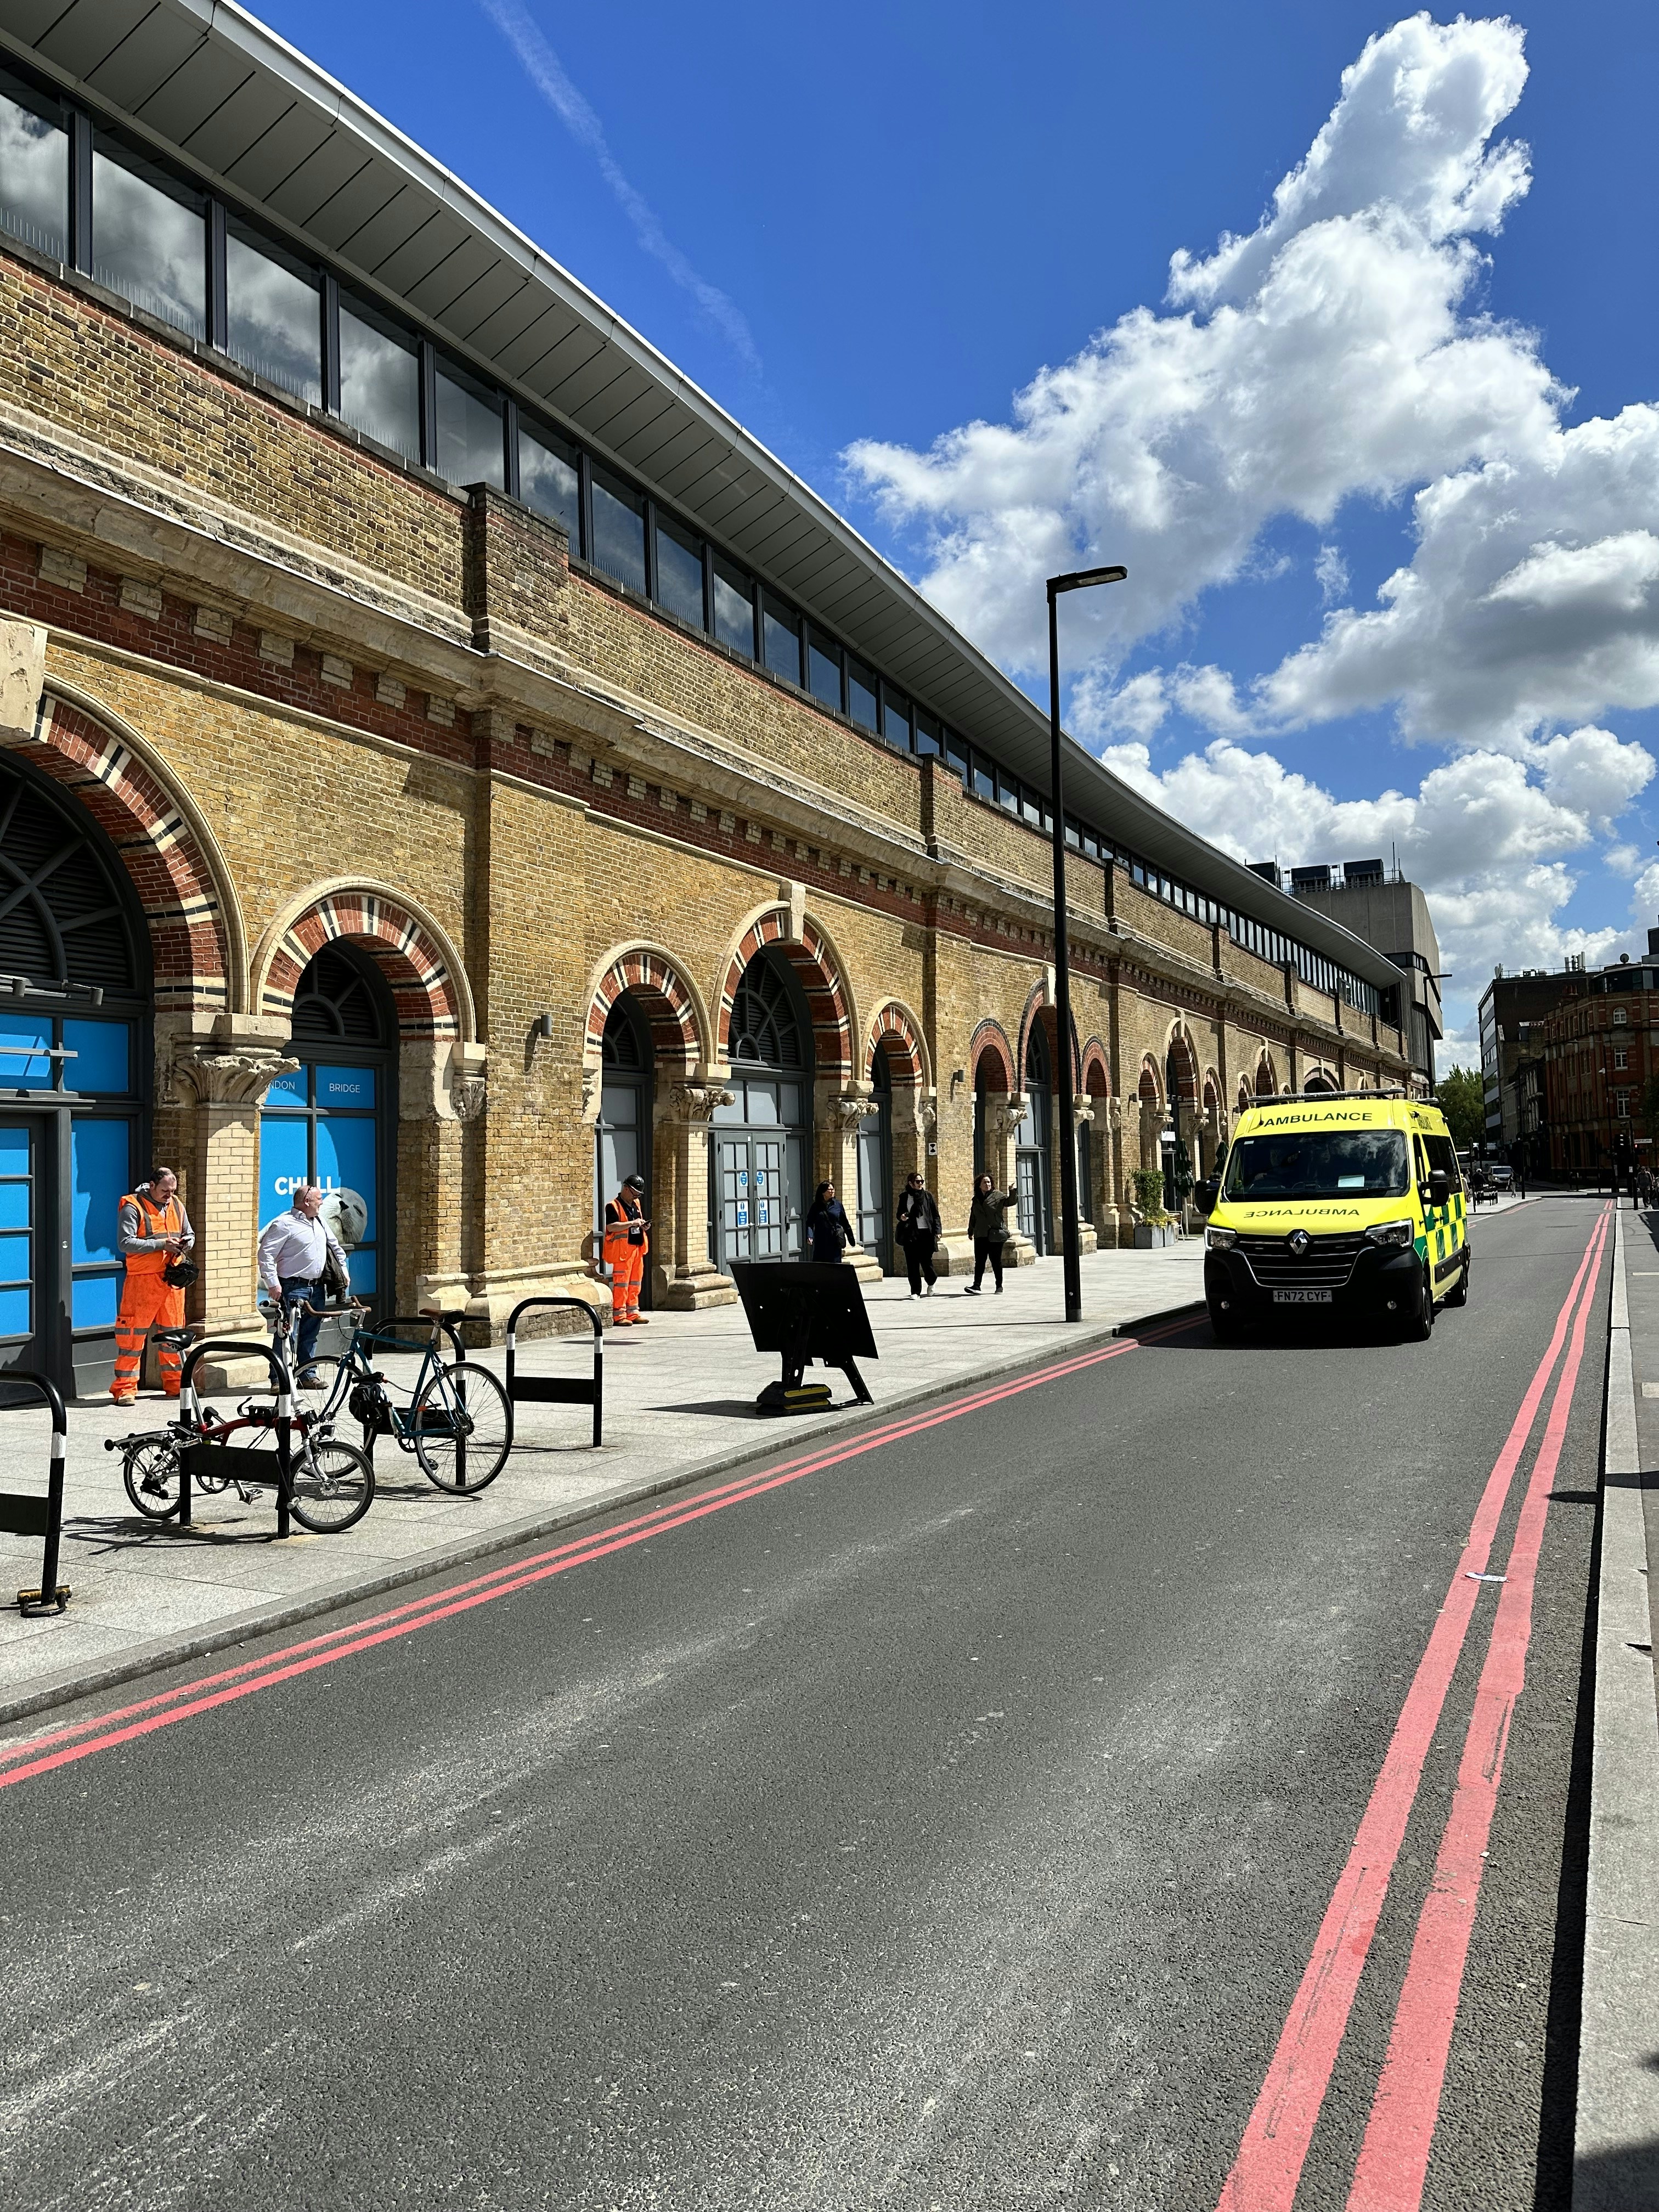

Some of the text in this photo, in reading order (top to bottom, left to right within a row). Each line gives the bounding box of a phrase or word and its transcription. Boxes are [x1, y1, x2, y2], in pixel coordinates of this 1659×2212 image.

[269, 1080, 360, 1093] NDON BRIDGE
[1263, 1113, 1373, 1127] AMBULANCE
[1277, 1291, 1328, 1301] FN72 CYF
